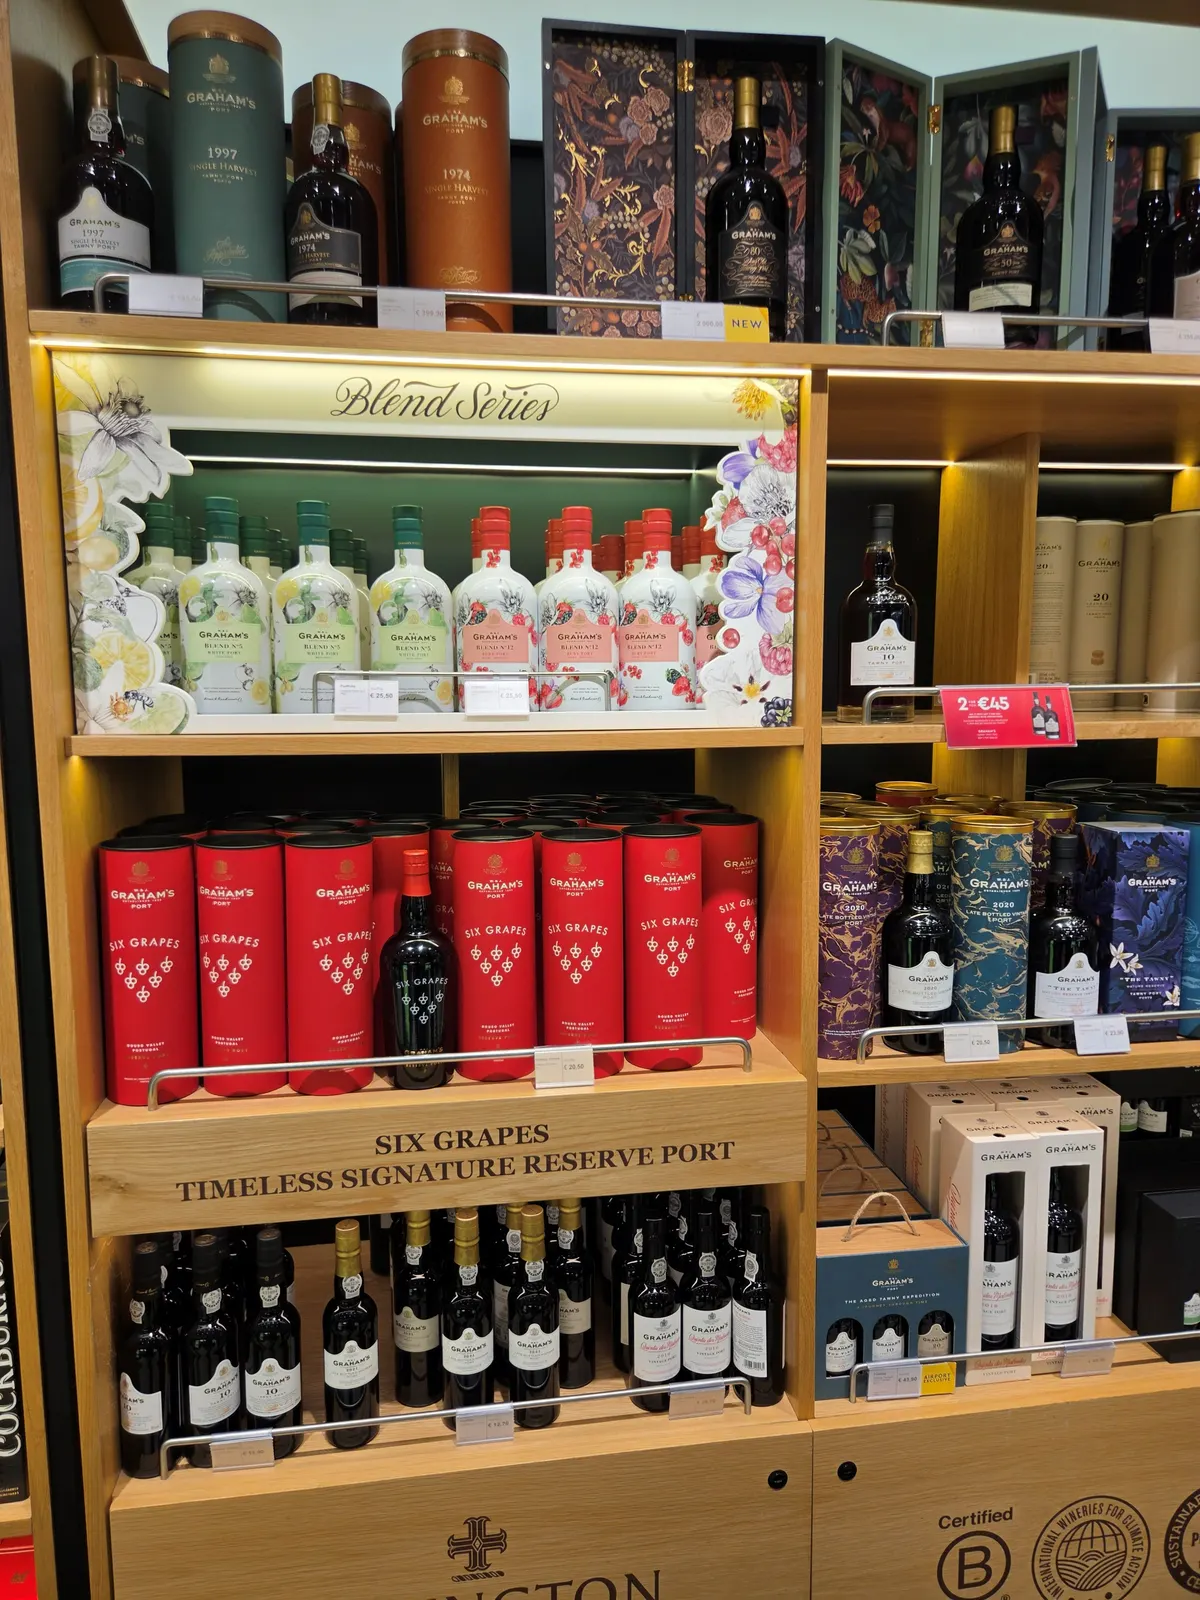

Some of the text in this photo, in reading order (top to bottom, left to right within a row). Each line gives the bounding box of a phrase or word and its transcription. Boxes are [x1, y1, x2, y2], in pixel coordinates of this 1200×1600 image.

[186, 92, 256, 110] GRAHAM'S
[422, 114, 488, 129] GRAHAM'S
[208, 146, 238, 160] 1997
[220, 162, 257, 177] HARVEST
[443, 168, 470, 182] 1974
[454, 183, 489, 196] HARVEST
[69, 218, 120, 228] GRAHAM'S
[82, 230, 104, 238] 1997
[290, 232, 330, 246] GRAHAM'S
[731, 230, 776, 240] GRAHAM'S
[298, 244, 316, 254] 1974
[983, 246, 1029, 256] GRAHAM'S
[732, 319, 762, 329] NEW
[330, 376, 560, 422] Blend Series
[1078, 560, 1120, 568] GRAHAM'S
[1093, 592, 1109, 602] 20
[198, 630, 249, 639] GRAHAM'S
[298, 632, 346, 640] GRAHAM'S
[390, 634, 436, 642] GRAHAM'S
[866, 644, 907, 652] GRAHAM'S
[957, 696, 1010, 711] 2 €45
[550, 878, 604, 888] GRAHAM'S
[644, 872, 696, 883] GRAHAM'S
[1128, 878, 1176, 887] GRAHAM'S
[467, 880, 523, 890] GRAHAM'S
[822, 880, 878, 892] GRAHAM'S
[970, 878, 1029, 889] GRAHAM'S
[110, 889, 175, 900] GRAHAM'S
[200, 885, 254, 897] GRAHAM'S
[316, 884, 370, 898] GRAHAM'S
[718, 901, 736, 914] SIX
[844, 904, 865, 912] 2020
[547, 923, 609, 936] SIX GRAPES
[640, 917, 699, 931] SIX GRAPES
[464, 925, 527, 939] SIX GRAPES
[109, 937, 180, 952] SIX GRAPES
[200, 933, 260, 948] SIX GRAPES
[312, 931, 372, 949] SIX GRAPES
[396, 978, 448, 989] SIX GRAPES
[908, 975, 948, 983] GRAHAM'S
[1027, 1118, 1079, 1126] GRAHAM'S
[966, 1124, 1017, 1132] GRAHAM'S
[374, 1124, 550, 1155] SIX GRAPES
[1045, 1144, 1097, 1154] GRAHAM'S
[980, 1151, 1032, 1162] GRAHAM'S
[175, 1140, 735, 1202] TIMELESS SIGNATURE RESERVE PORT
[872, 1277, 914, 1287] GRAHAM'S
[395, 1320, 426, 1330] GRAHAM'S
[691, 1322, 729, 1333] GRAHAM'S
[643, 1328, 679, 1341] GRAHAM'S
[450, 1342, 487, 1353] GRAHAM'S
[516, 1340, 552, 1348] GRAHAM'S
[333, 1355, 370, 1367] GRAHAM'S
[252, 1375, 290, 1386] GRAHAM'S
[923, 1372, 951, 1380] AIRPORT
[204, 1373, 239, 1395] GRAHAM'S
[219, 1389, 231, 1399] 10
[938, 1507, 1014, 1530] Certified
[1038, 1502, 1144, 1600] INTERNATIONAL WINERIES FOR CLIMATE ACTION
[958, 1544, 993, 1590] B
